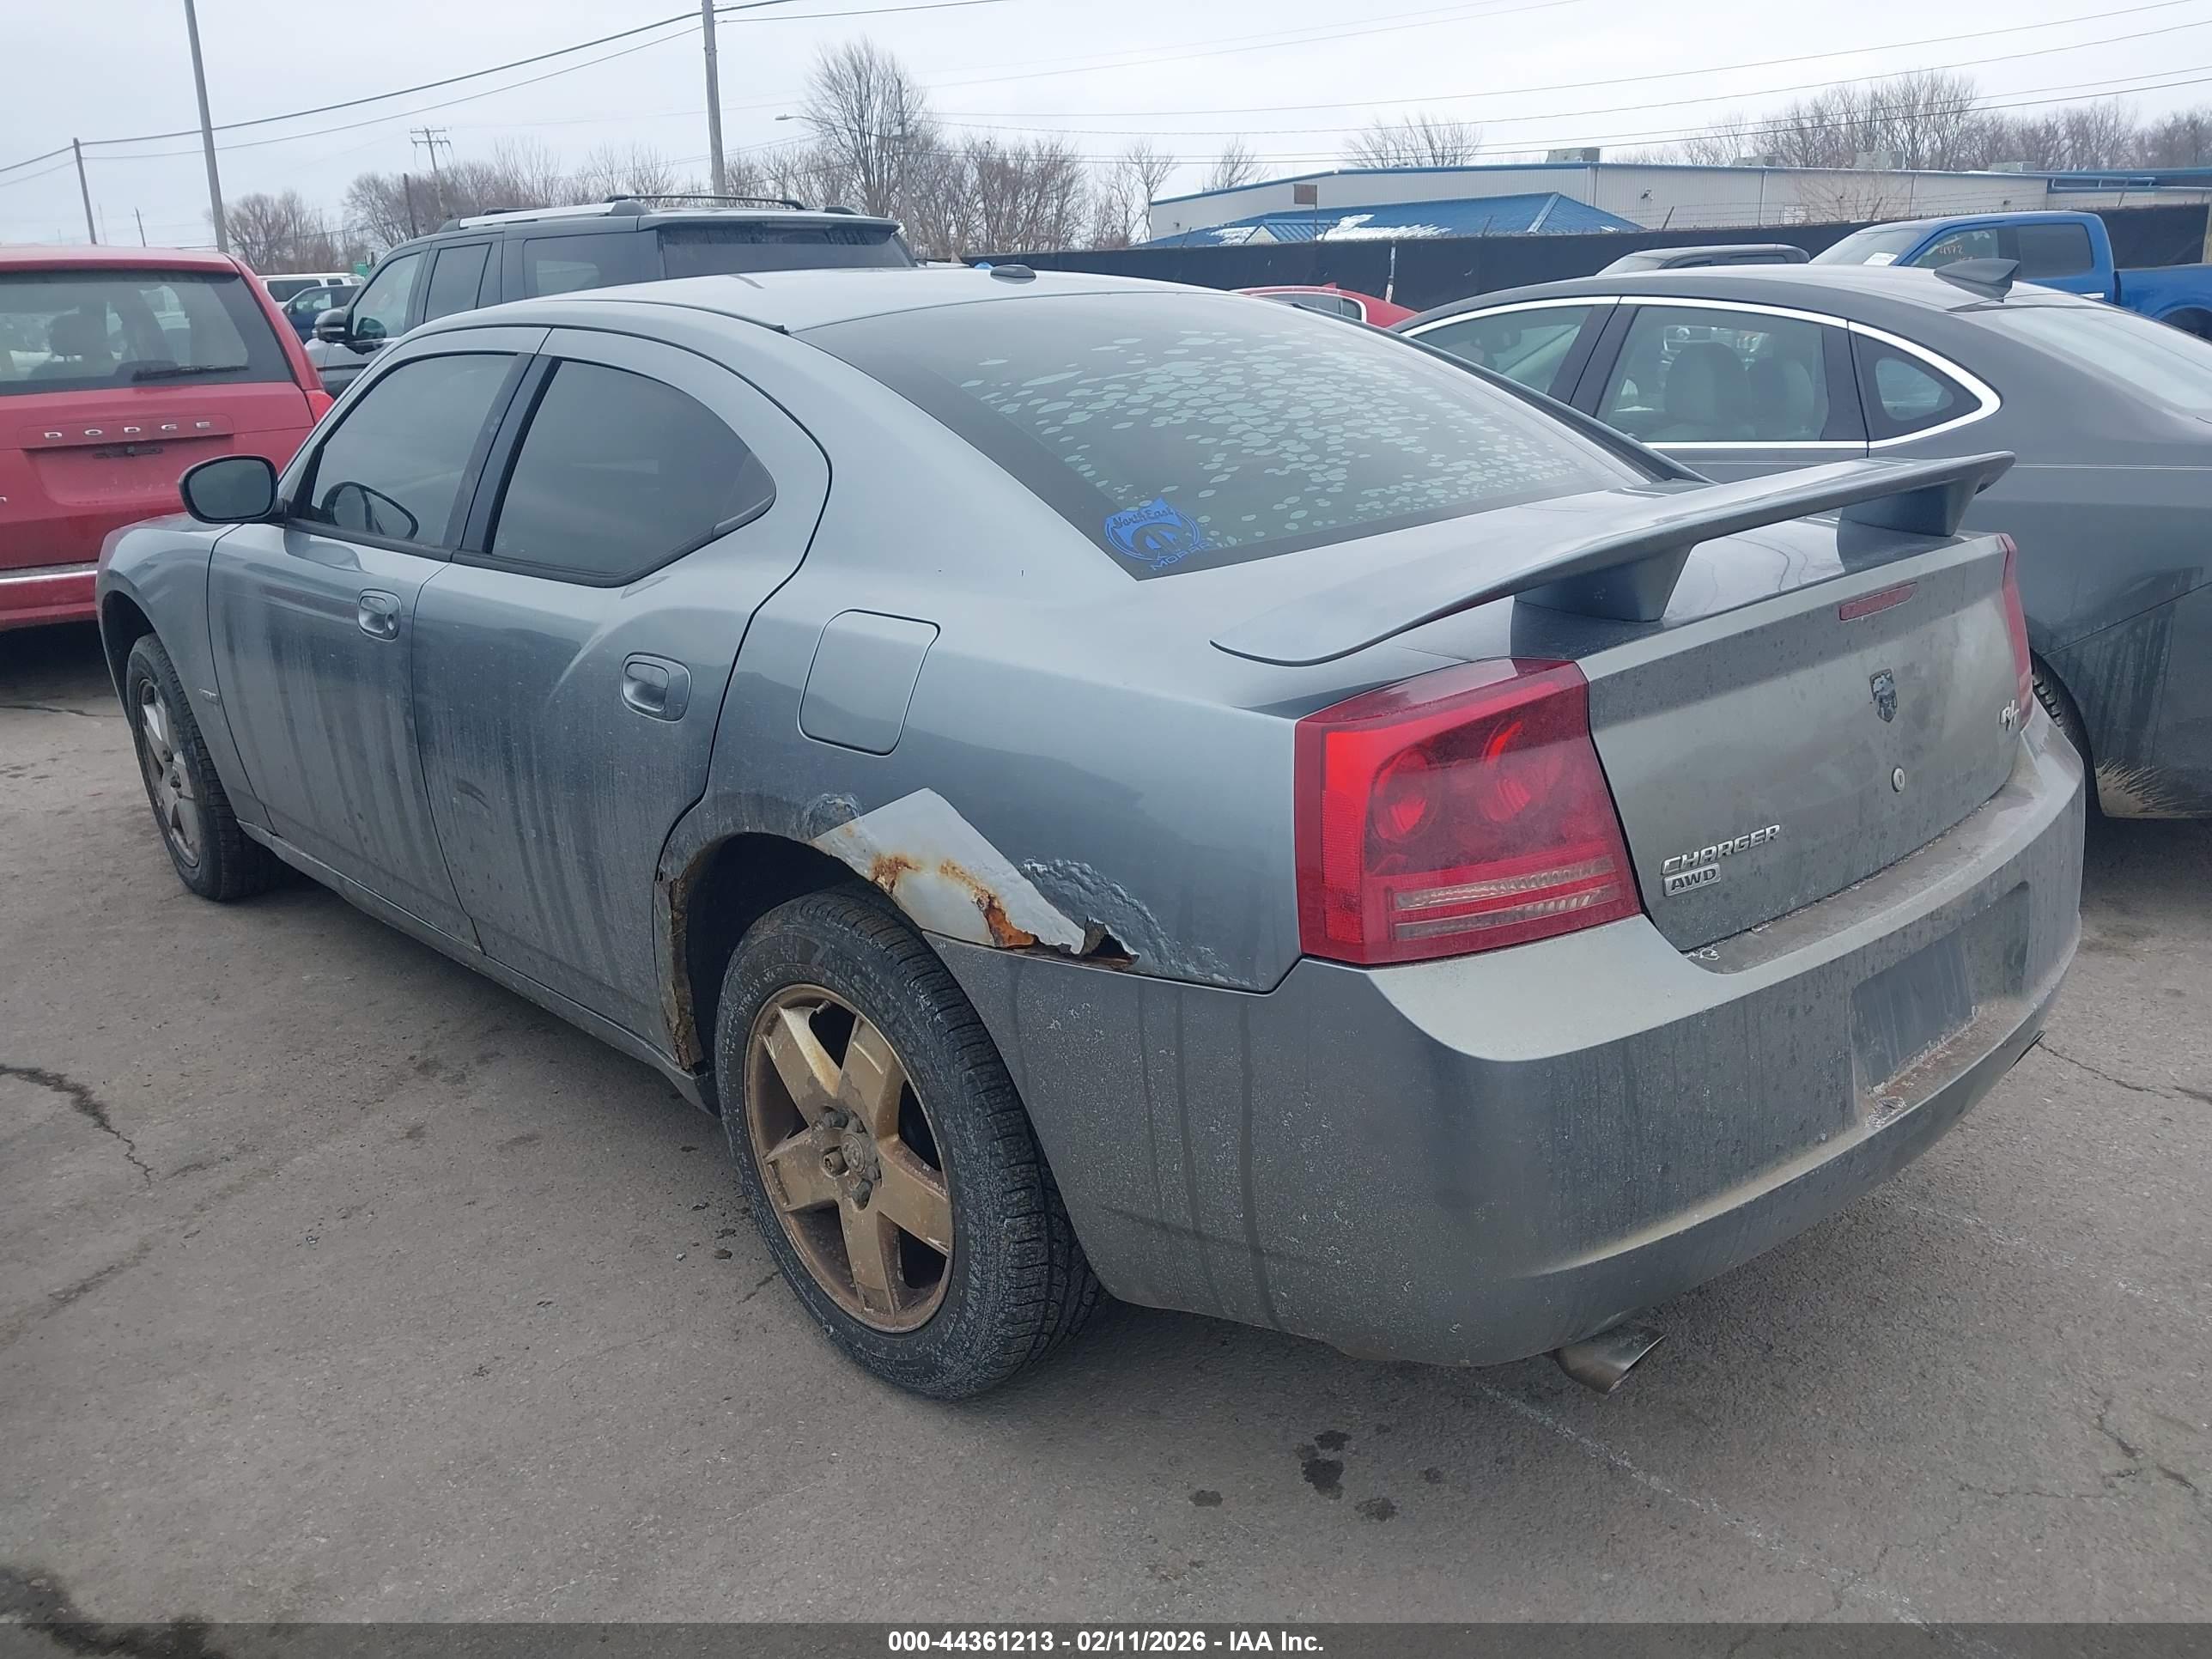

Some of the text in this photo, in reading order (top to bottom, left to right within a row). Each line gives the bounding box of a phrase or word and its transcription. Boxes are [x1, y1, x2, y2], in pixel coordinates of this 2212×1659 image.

[44, 421, 211, 439] DODGE
[1661, 823, 1780, 875] CHARGER
[1671, 868, 1717, 890] AWD
